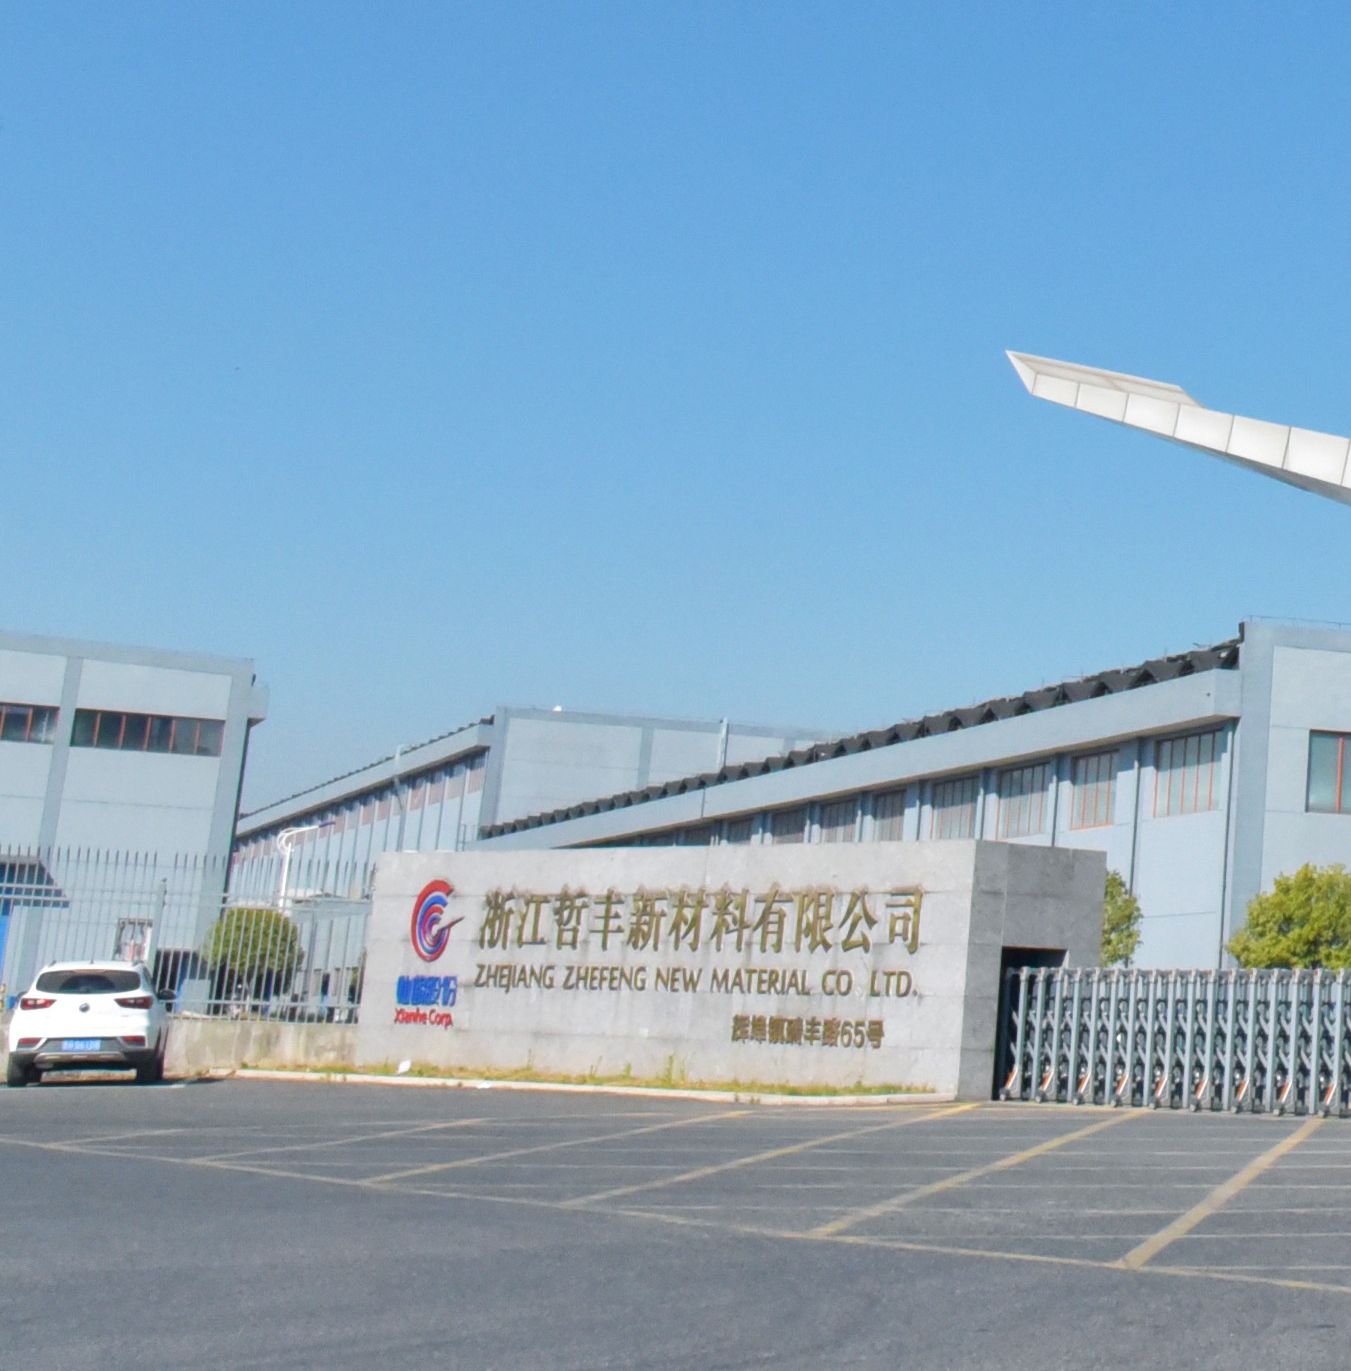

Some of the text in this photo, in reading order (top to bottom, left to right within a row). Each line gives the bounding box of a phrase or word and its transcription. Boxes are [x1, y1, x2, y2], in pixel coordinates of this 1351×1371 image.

[477, 884, 926, 955] 浙江哲丰新材料有限公司
[474, 963, 919, 997] ZHEJIANG ZHEFENG NEW MATERIAL CO LTD.
